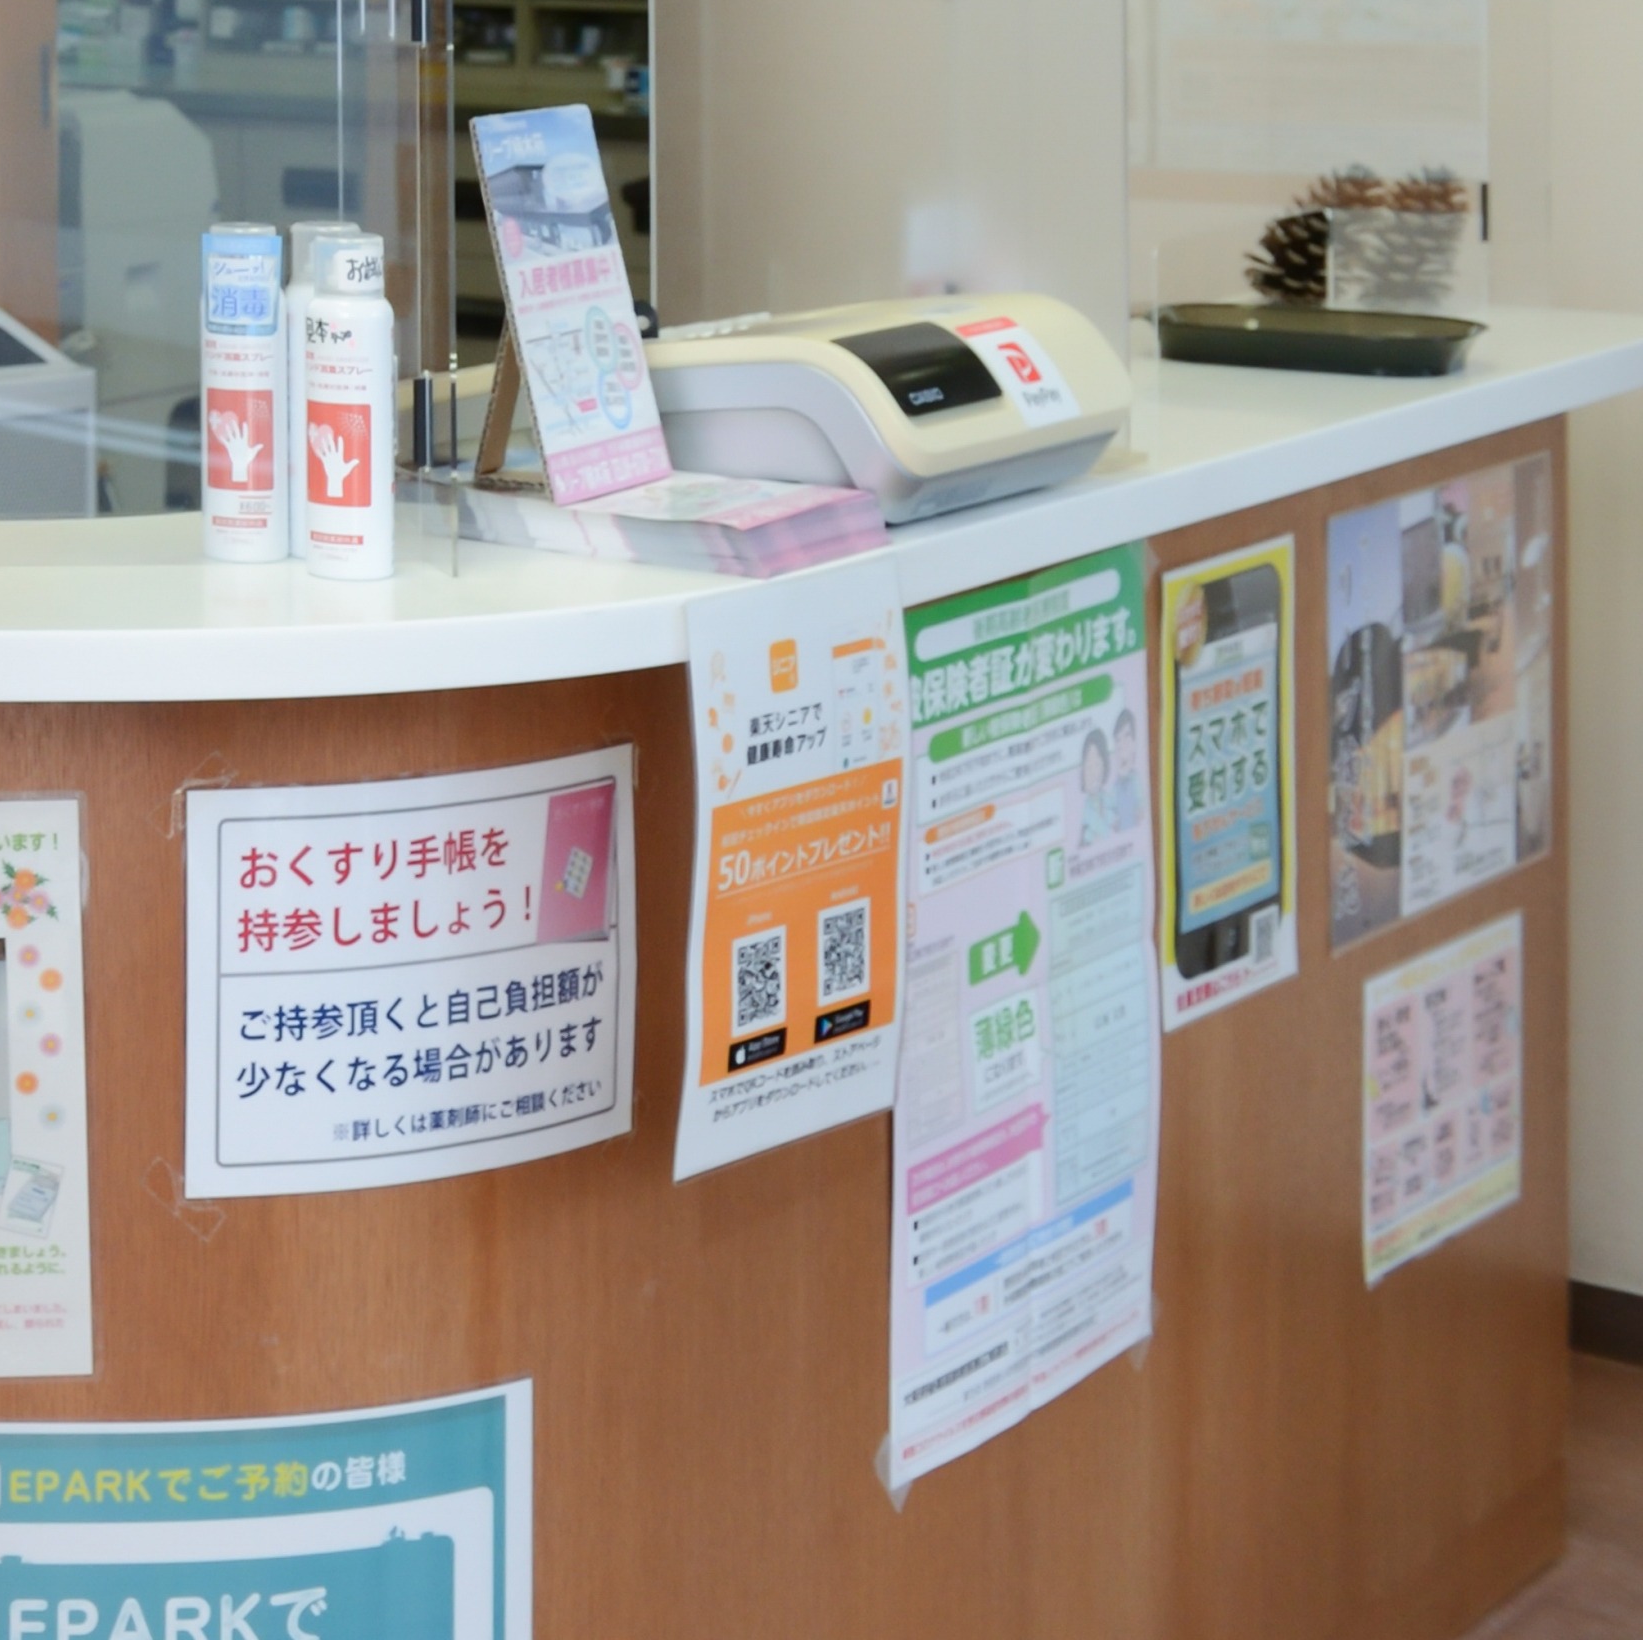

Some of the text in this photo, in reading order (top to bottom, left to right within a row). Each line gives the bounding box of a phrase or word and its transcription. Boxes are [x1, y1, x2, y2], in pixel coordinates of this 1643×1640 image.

[211, 286, 269, 319] 消毒
[1022, 387, 1062, 409] PayPay
[746, 725, 827, 766] 健康寿命アップ
[749, 701, 822, 739] 楽天シニアで
[1189, 699, 1268, 762] スマホで
[1188, 748, 1268, 814] 受付する
[239, 826, 510, 890] おくすり手帳を
[238, 885, 531, 953] 持参しましょう!
[240, 960, 604, 1042] ご持参頂くと自己負担額が
[236, 1016, 603, 1099] 少なくなる場合があります
[9, 1450, 408, 1504] EPARKでご予約の皆様
